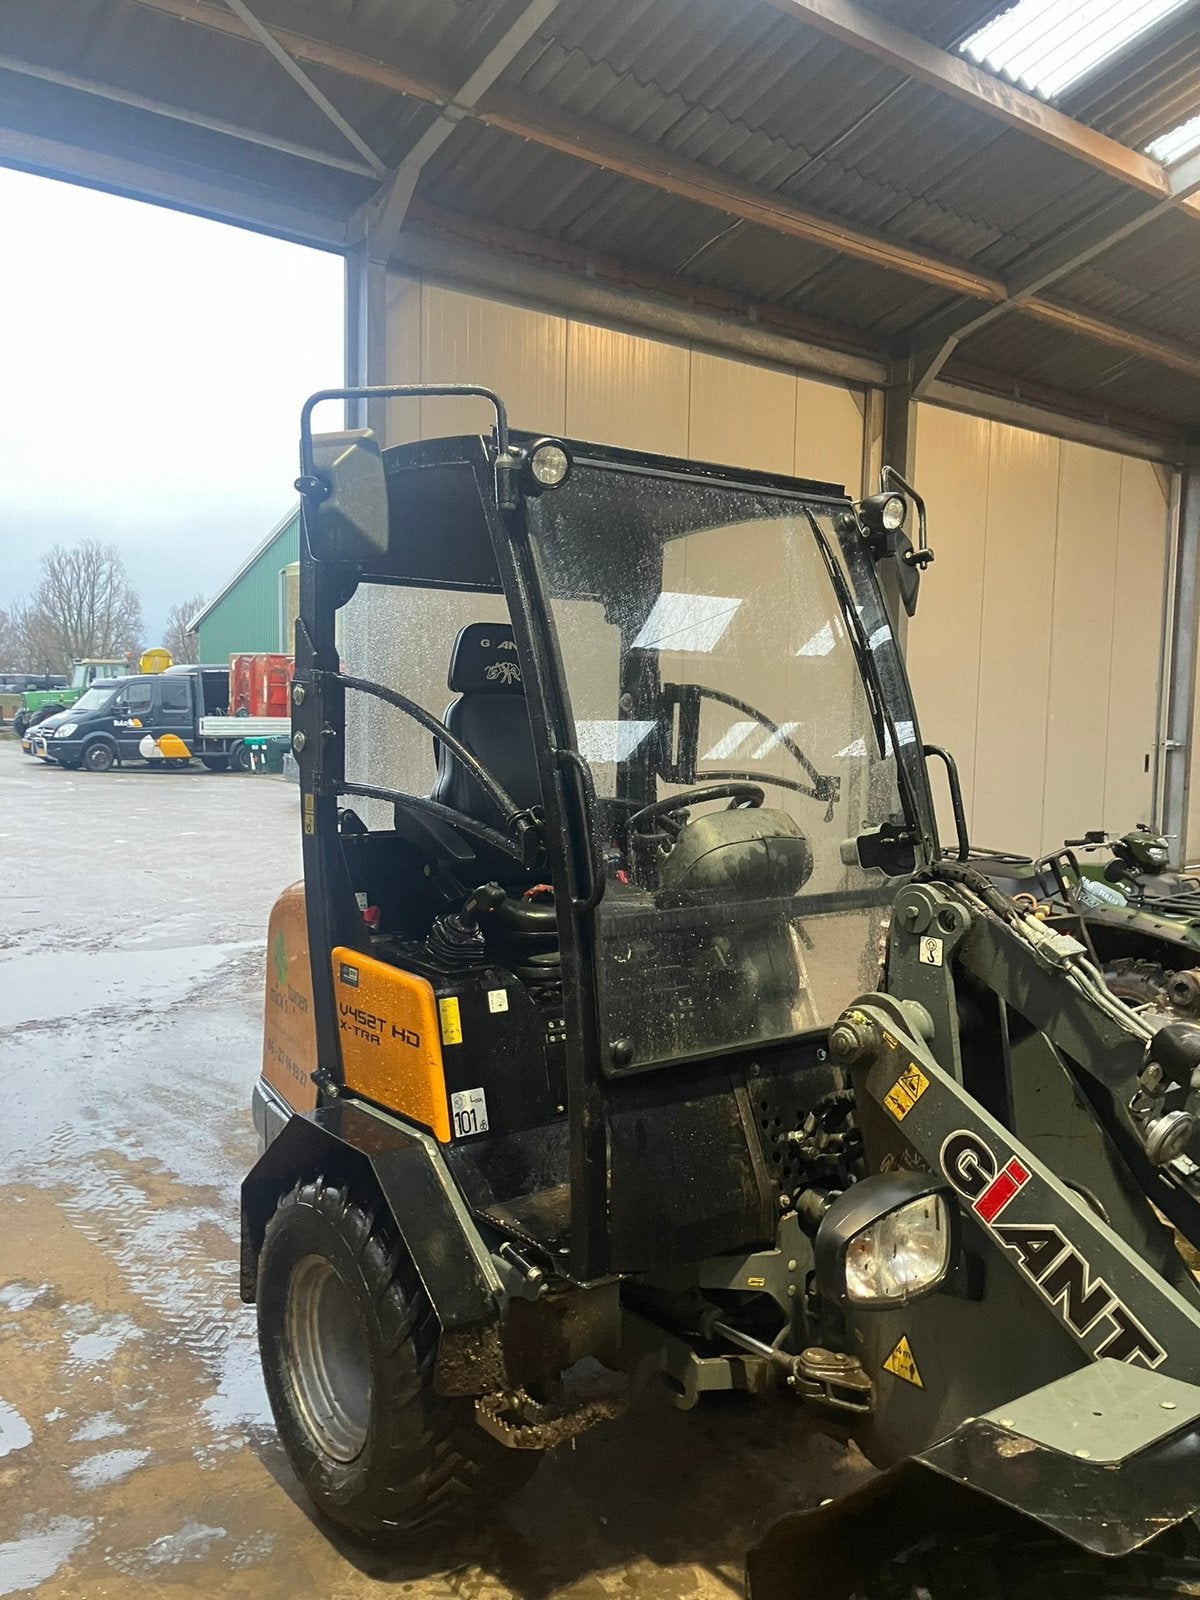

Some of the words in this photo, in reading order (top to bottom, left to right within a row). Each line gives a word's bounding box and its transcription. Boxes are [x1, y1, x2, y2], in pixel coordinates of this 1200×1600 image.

[480, 638, 517, 650] GAN
[339, 1018, 380, 1046] X-TRA
[391, 1024, 420, 1048] HD
[454, 1108, 478, 1136] 101
